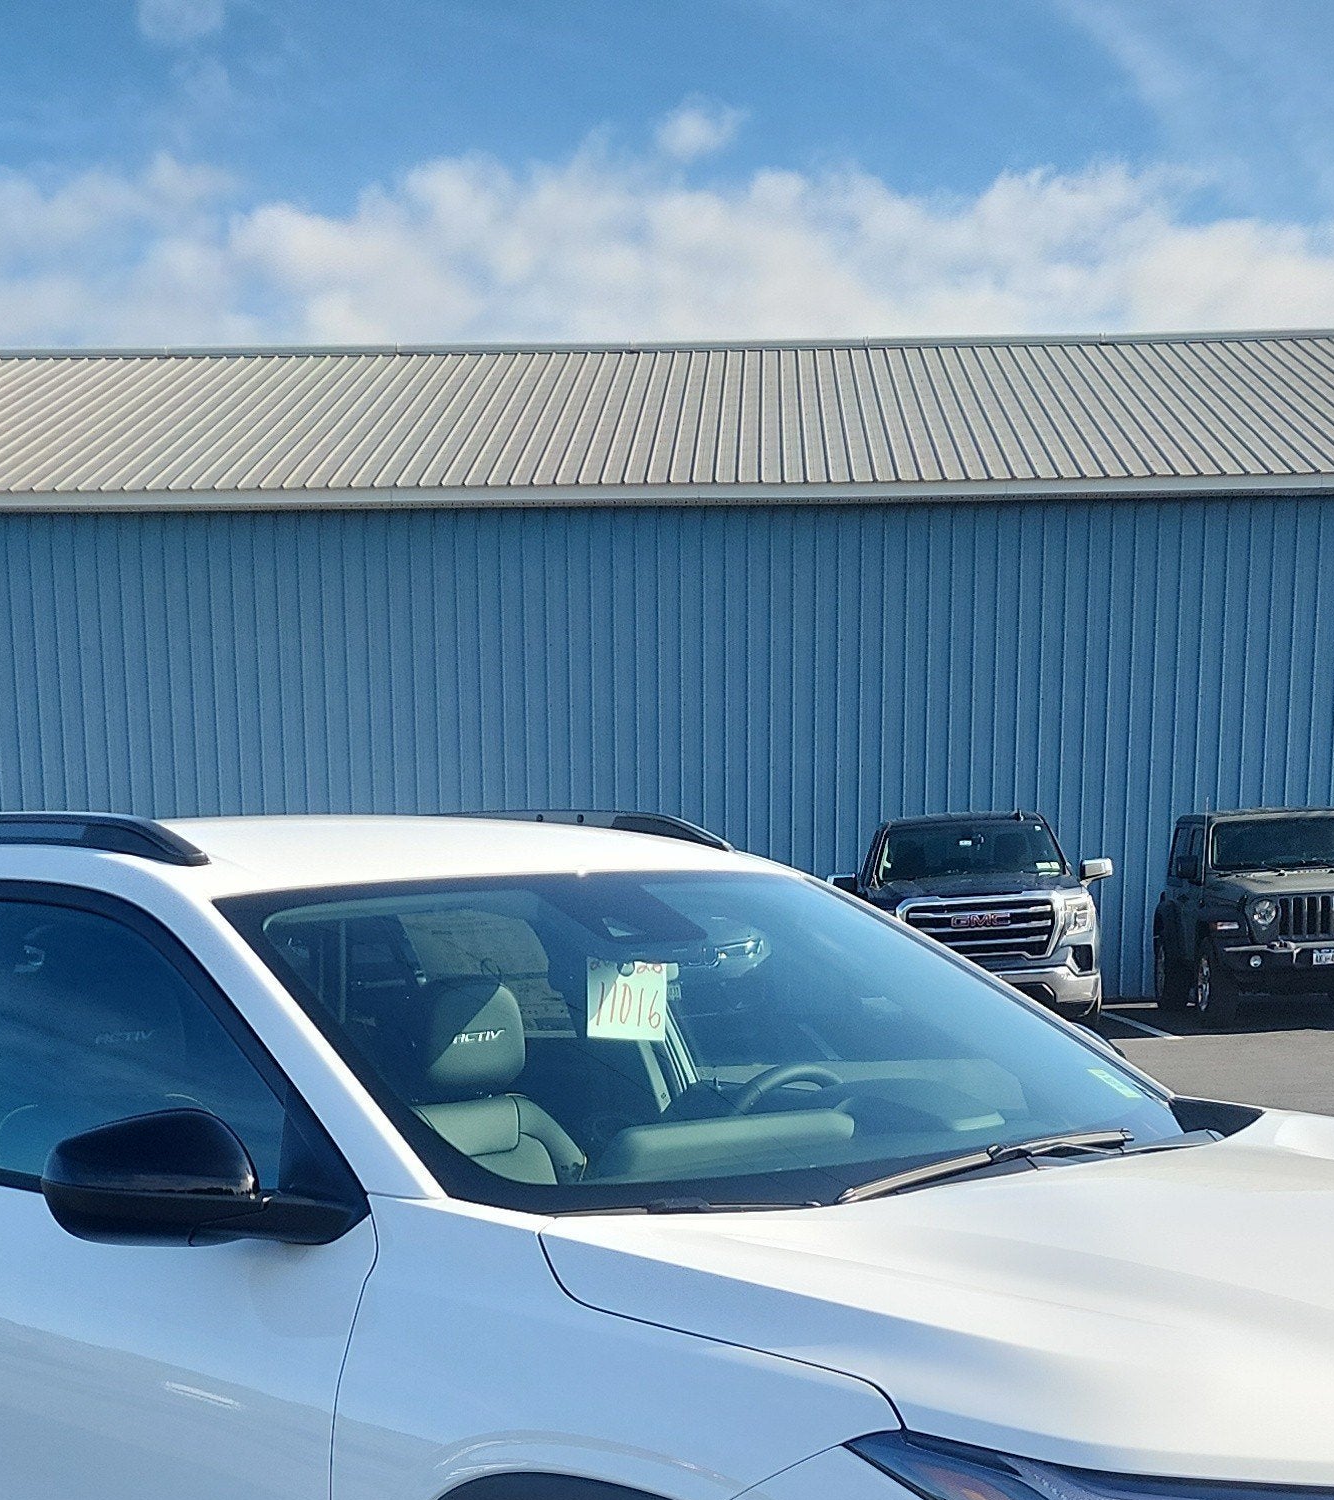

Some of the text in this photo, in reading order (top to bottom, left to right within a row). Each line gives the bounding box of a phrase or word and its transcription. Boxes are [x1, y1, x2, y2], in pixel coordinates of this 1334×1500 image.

[951, 912, 1011, 928] GMC
[595, 981, 662, 1030] 11016
[452, 1029, 506, 1044] ACTIV
